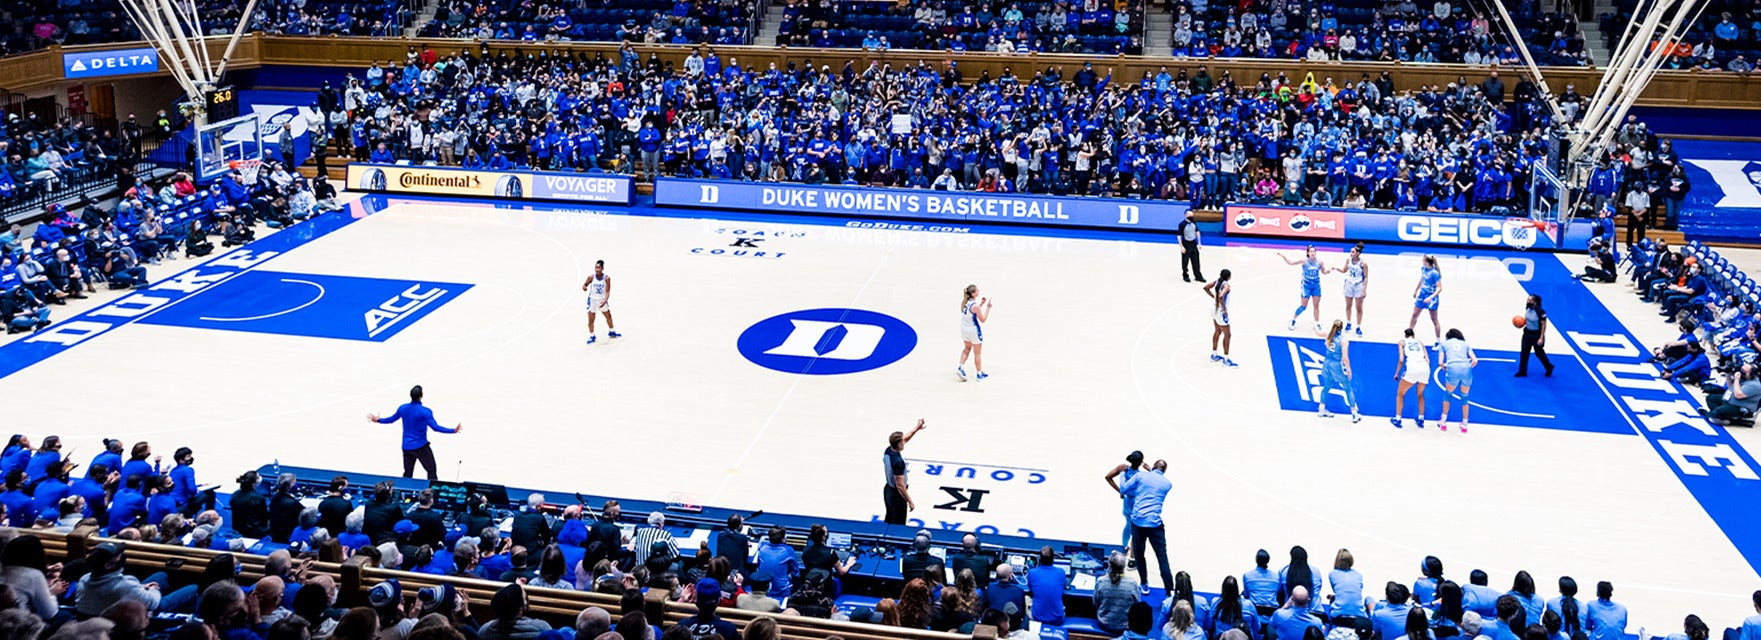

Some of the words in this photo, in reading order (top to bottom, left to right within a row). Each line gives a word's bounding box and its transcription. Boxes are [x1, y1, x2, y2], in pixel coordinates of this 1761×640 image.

[91, 55, 152, 69] DELTA
[399, 171, 470, 188] Continental
[545, 176, 616, 193] VOYAGER
[700, 185, 719, 203] D
[762, 188, 818, 208] DUKE
[824, 191, 920, 212] WOMEN'S
[926, 196, 1069, 220] BASKETBALL
[1118, 204, 1139, 225] D
[1397, 215, 1537, 246] GEICO
[690, 247, 786, 258] COURT
[729, 237, 766, 248] K
[24, 249, 279, 347] DUKE
[364, 283, 442, 333] ACC
[762, 318, 886, 361] D
[1566, 330, 1761, 480] DUKE
[904, 462, 1046, 484] COUR
[933, 486, 990, 513] K
